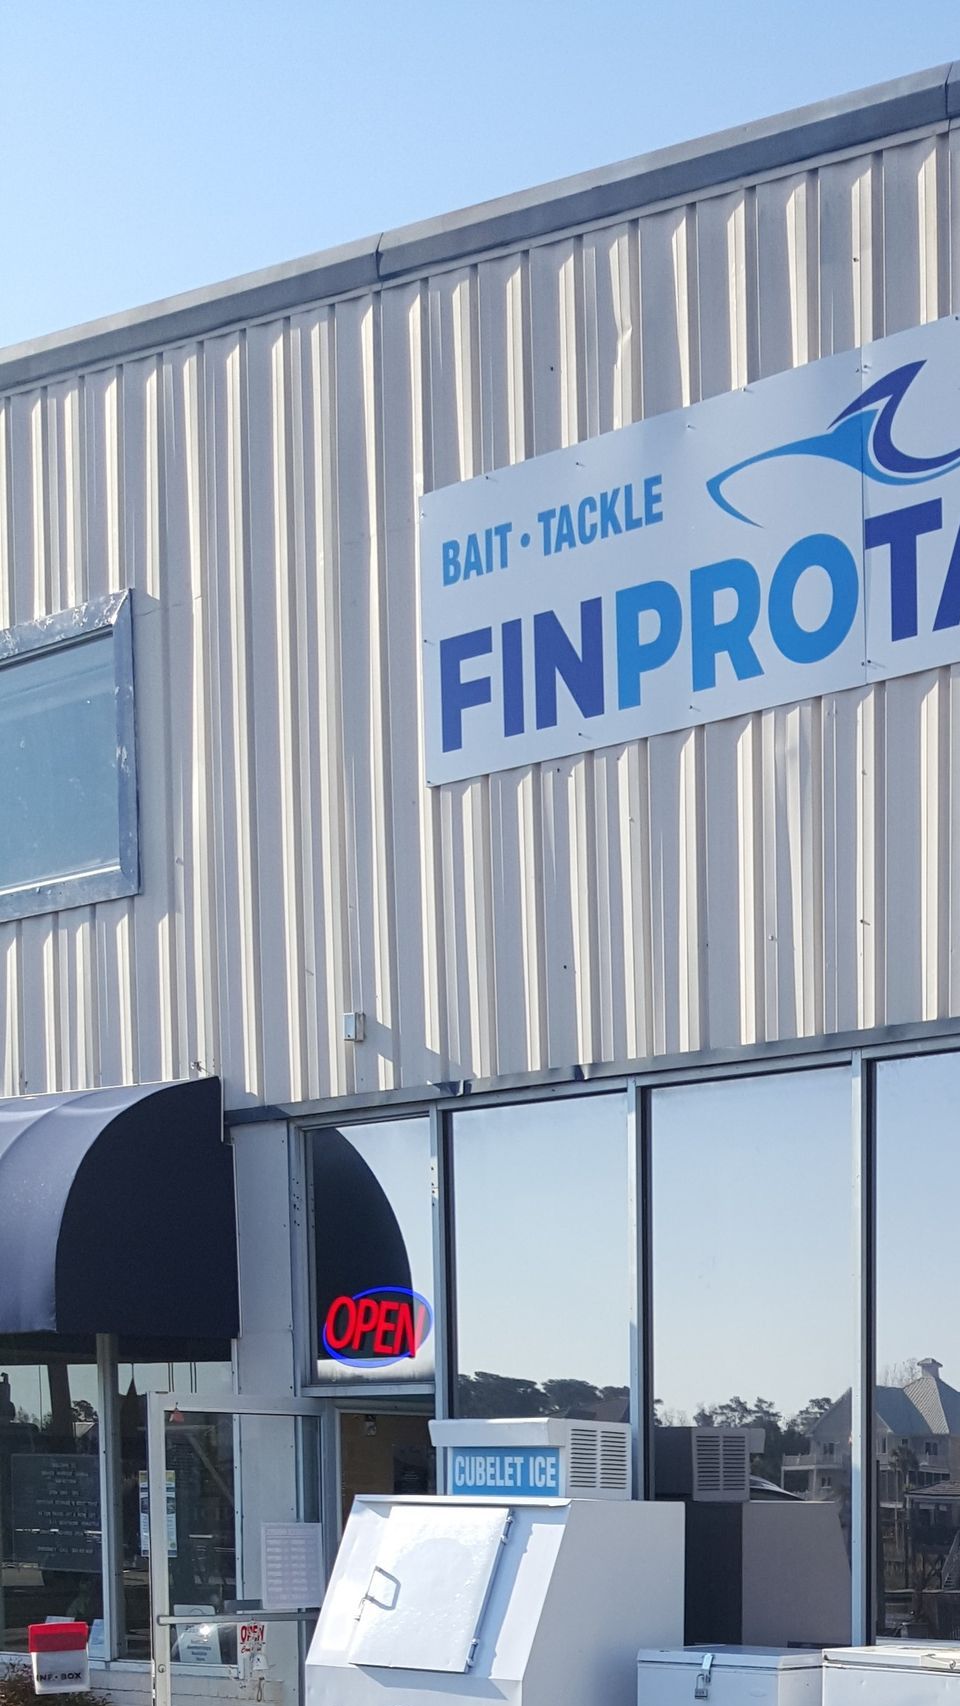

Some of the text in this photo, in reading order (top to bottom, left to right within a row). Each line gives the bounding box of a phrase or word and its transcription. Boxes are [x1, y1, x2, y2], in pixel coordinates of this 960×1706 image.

[442, 474, 663, 586] BAIT TACKLE
[326, 1295, 426, 1359] OPEN
[454, 1455, 557, 1487] CUBELET ICE
